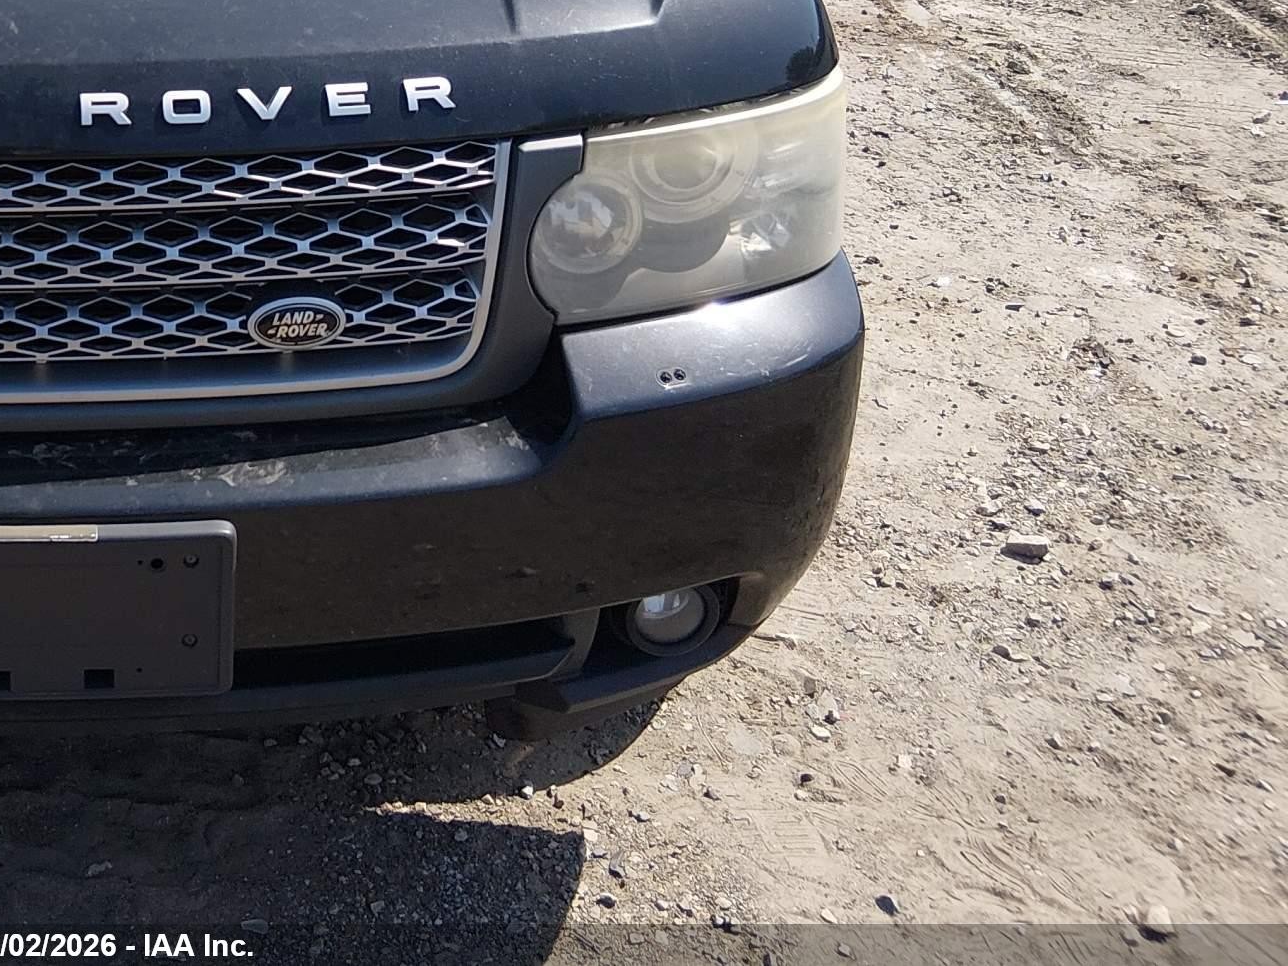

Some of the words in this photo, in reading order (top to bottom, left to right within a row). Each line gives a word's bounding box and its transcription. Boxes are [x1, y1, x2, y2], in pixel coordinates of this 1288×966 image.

[79, 76, 456, 126] ROVER
[272, 310, 314, 326] LAND
[276, 323, 328, 338] ROVER
